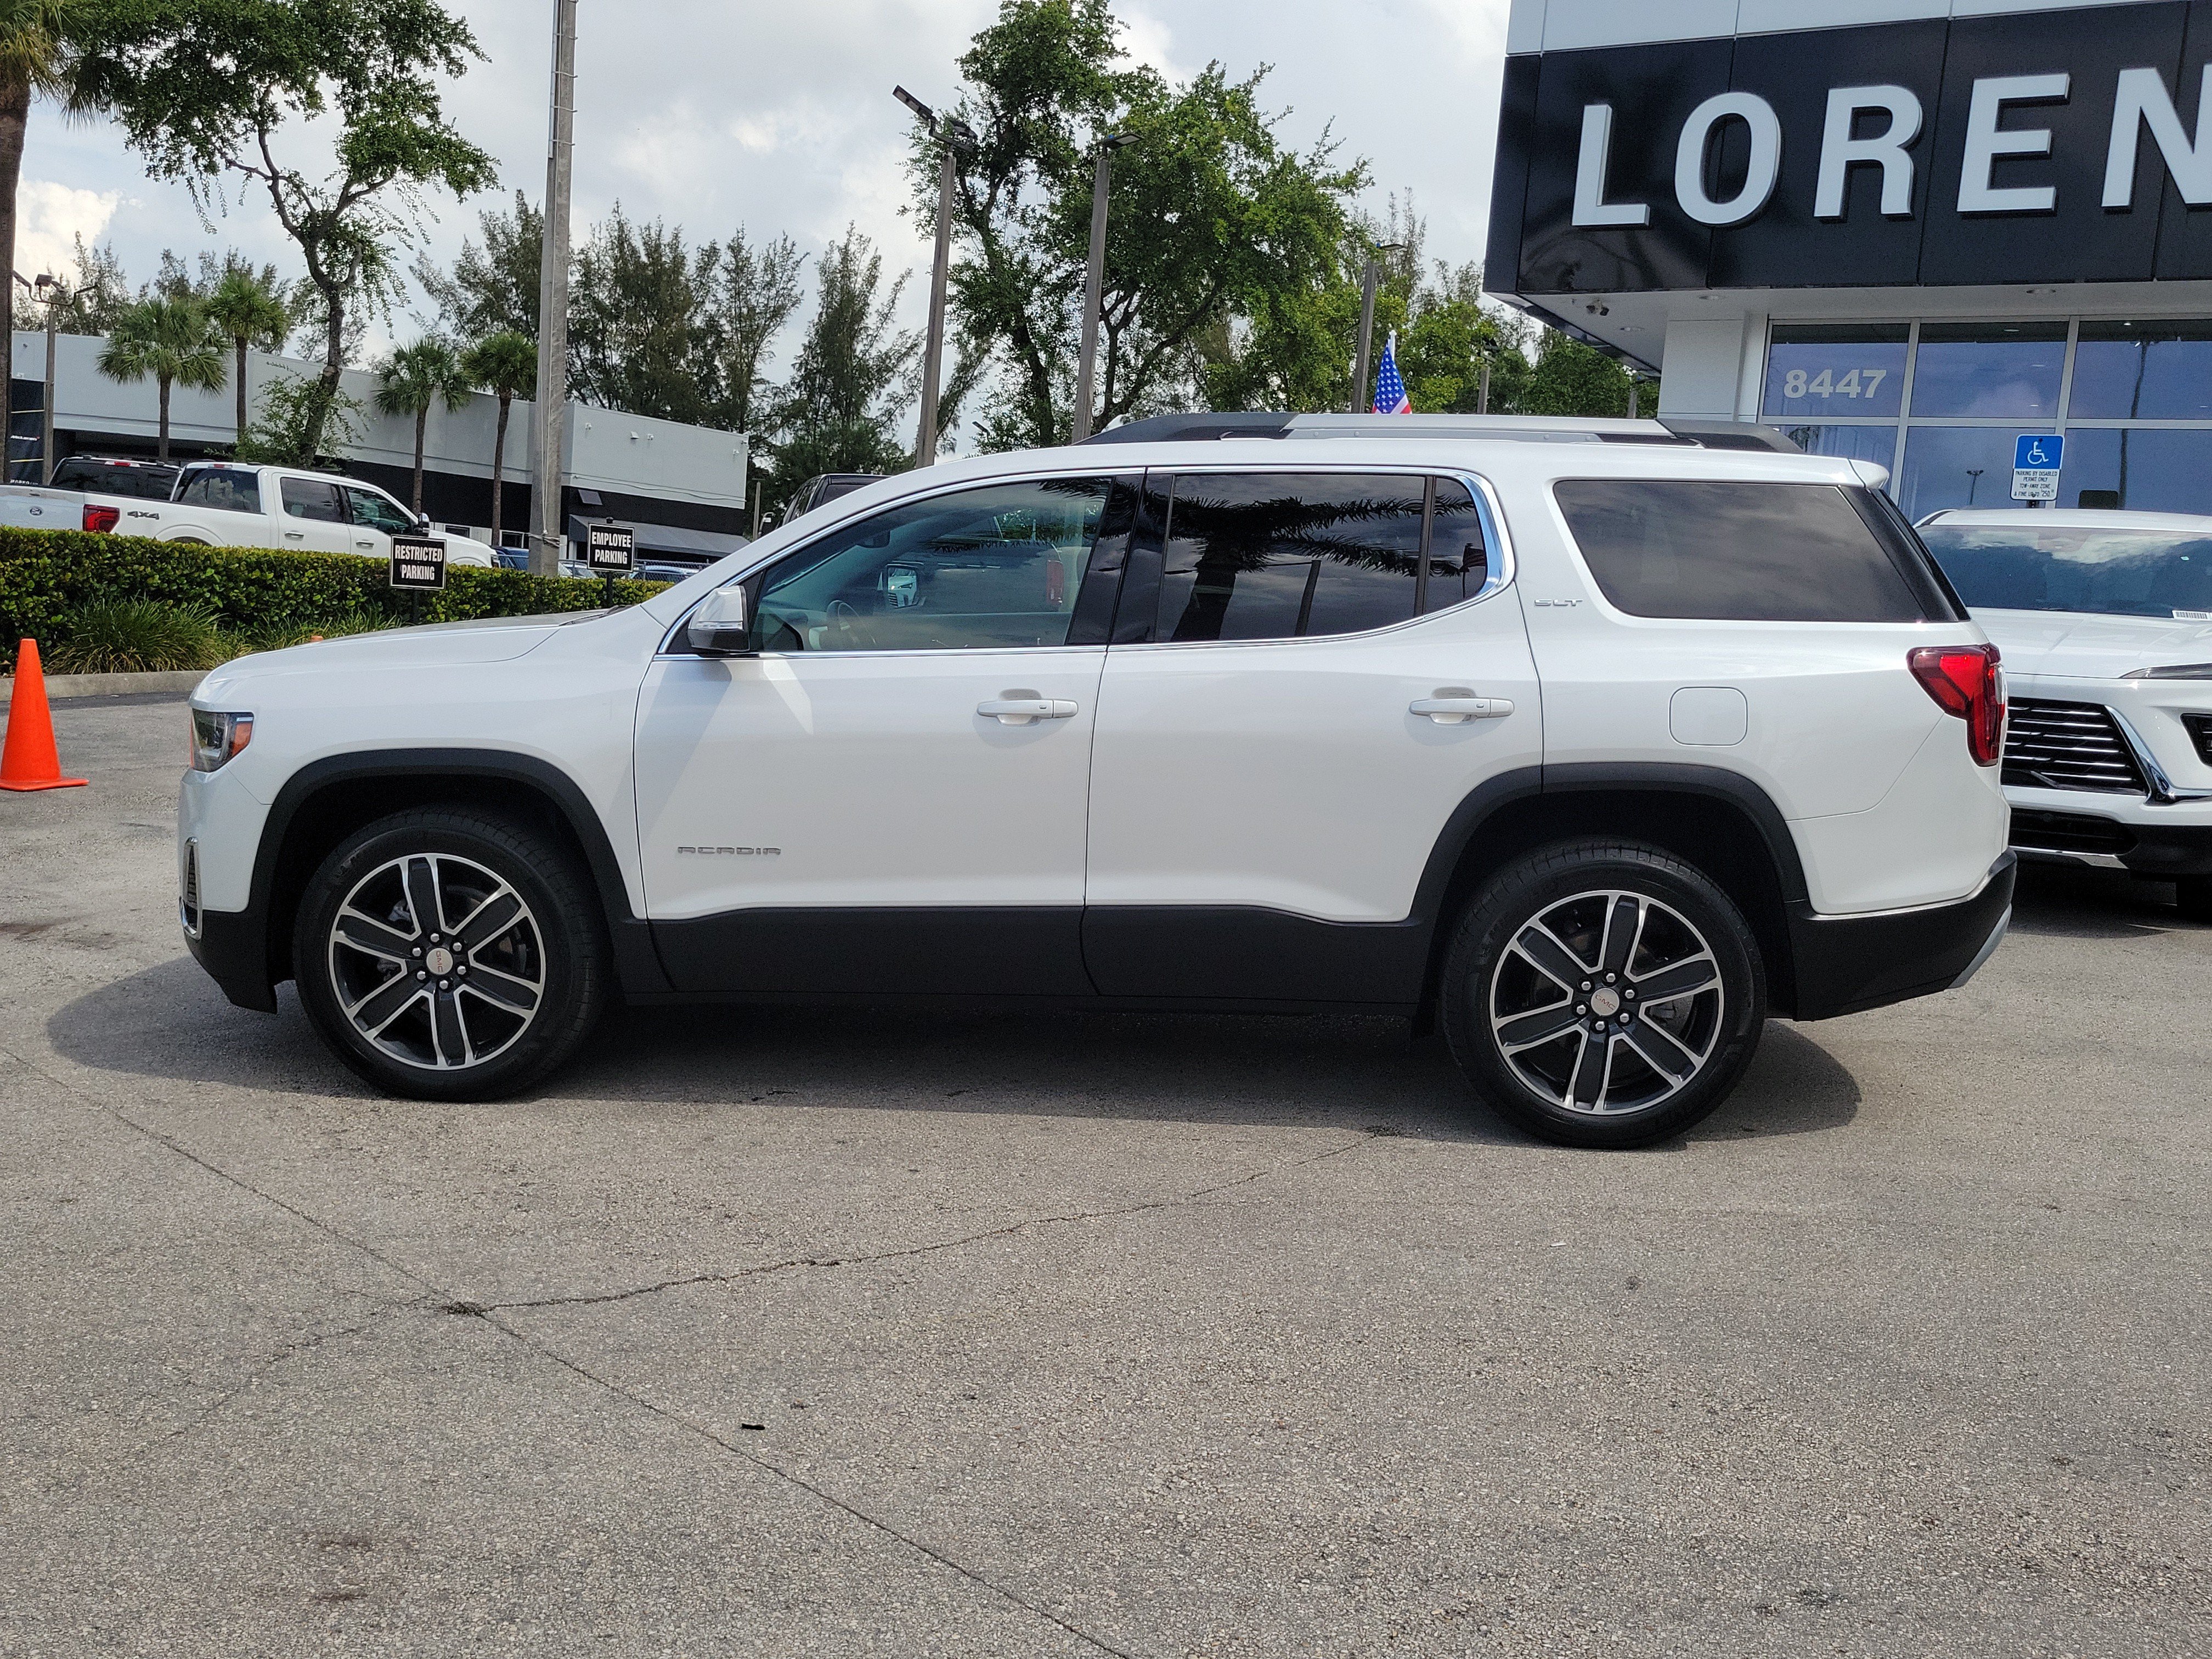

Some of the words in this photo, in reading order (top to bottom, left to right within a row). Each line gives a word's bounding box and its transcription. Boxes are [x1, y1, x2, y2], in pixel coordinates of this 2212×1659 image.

[1571, 64, 2212, 228] LOREN
[1784, 369, 1887, 398] 8447
[591, 531, 631, 548] EMPLOYEE
[394, 544, 443, 562] RESTRICTED
[595, 549, 628, 565] PARKING
[401, 564, 435, 580] PARKING
[1534, 599, 1584, 607] SLT
[677, 846, 781, 855] ACADIA
[1595, 994, 1616, 1011] GMC
